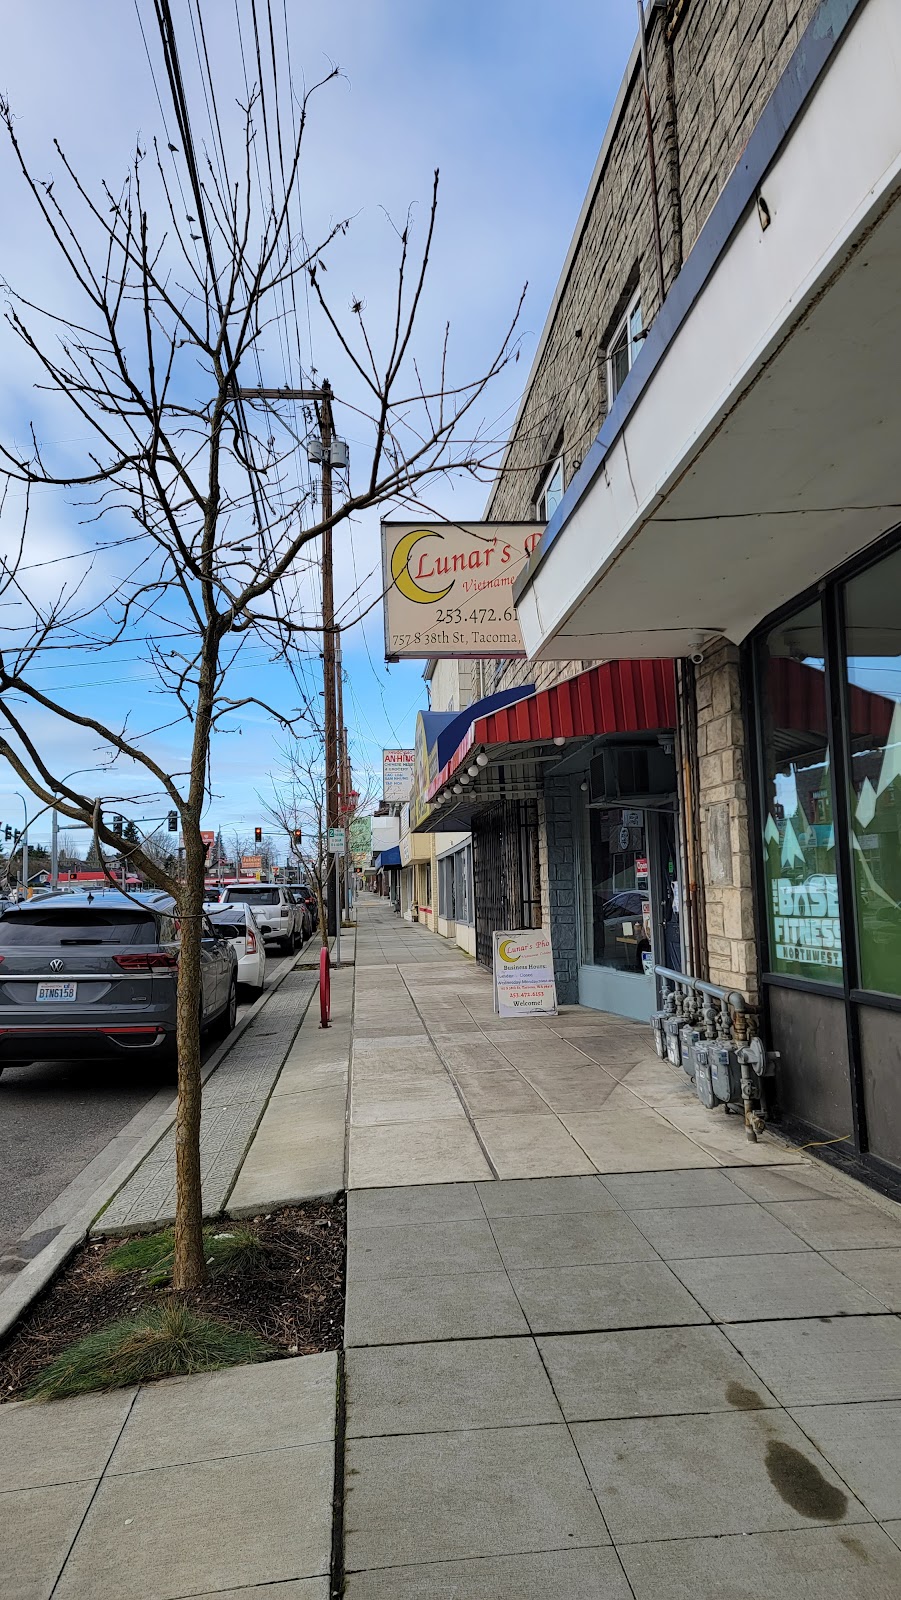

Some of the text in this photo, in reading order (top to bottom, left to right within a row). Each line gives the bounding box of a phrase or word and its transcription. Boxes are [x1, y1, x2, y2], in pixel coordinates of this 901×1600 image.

[414, 537, 511, 579] Lunar's
[462, 576, 515, 593] Vietname
[435, 608, 519, 624] 253.472.61
[393, 631, 521, 646] 757 S 38th St, Tacoma,
[637, 862, 648, 872] Open
[507, 940, 550, 954] Lunar's Pho
[783, 946, 839, 965] NORTHWEST
